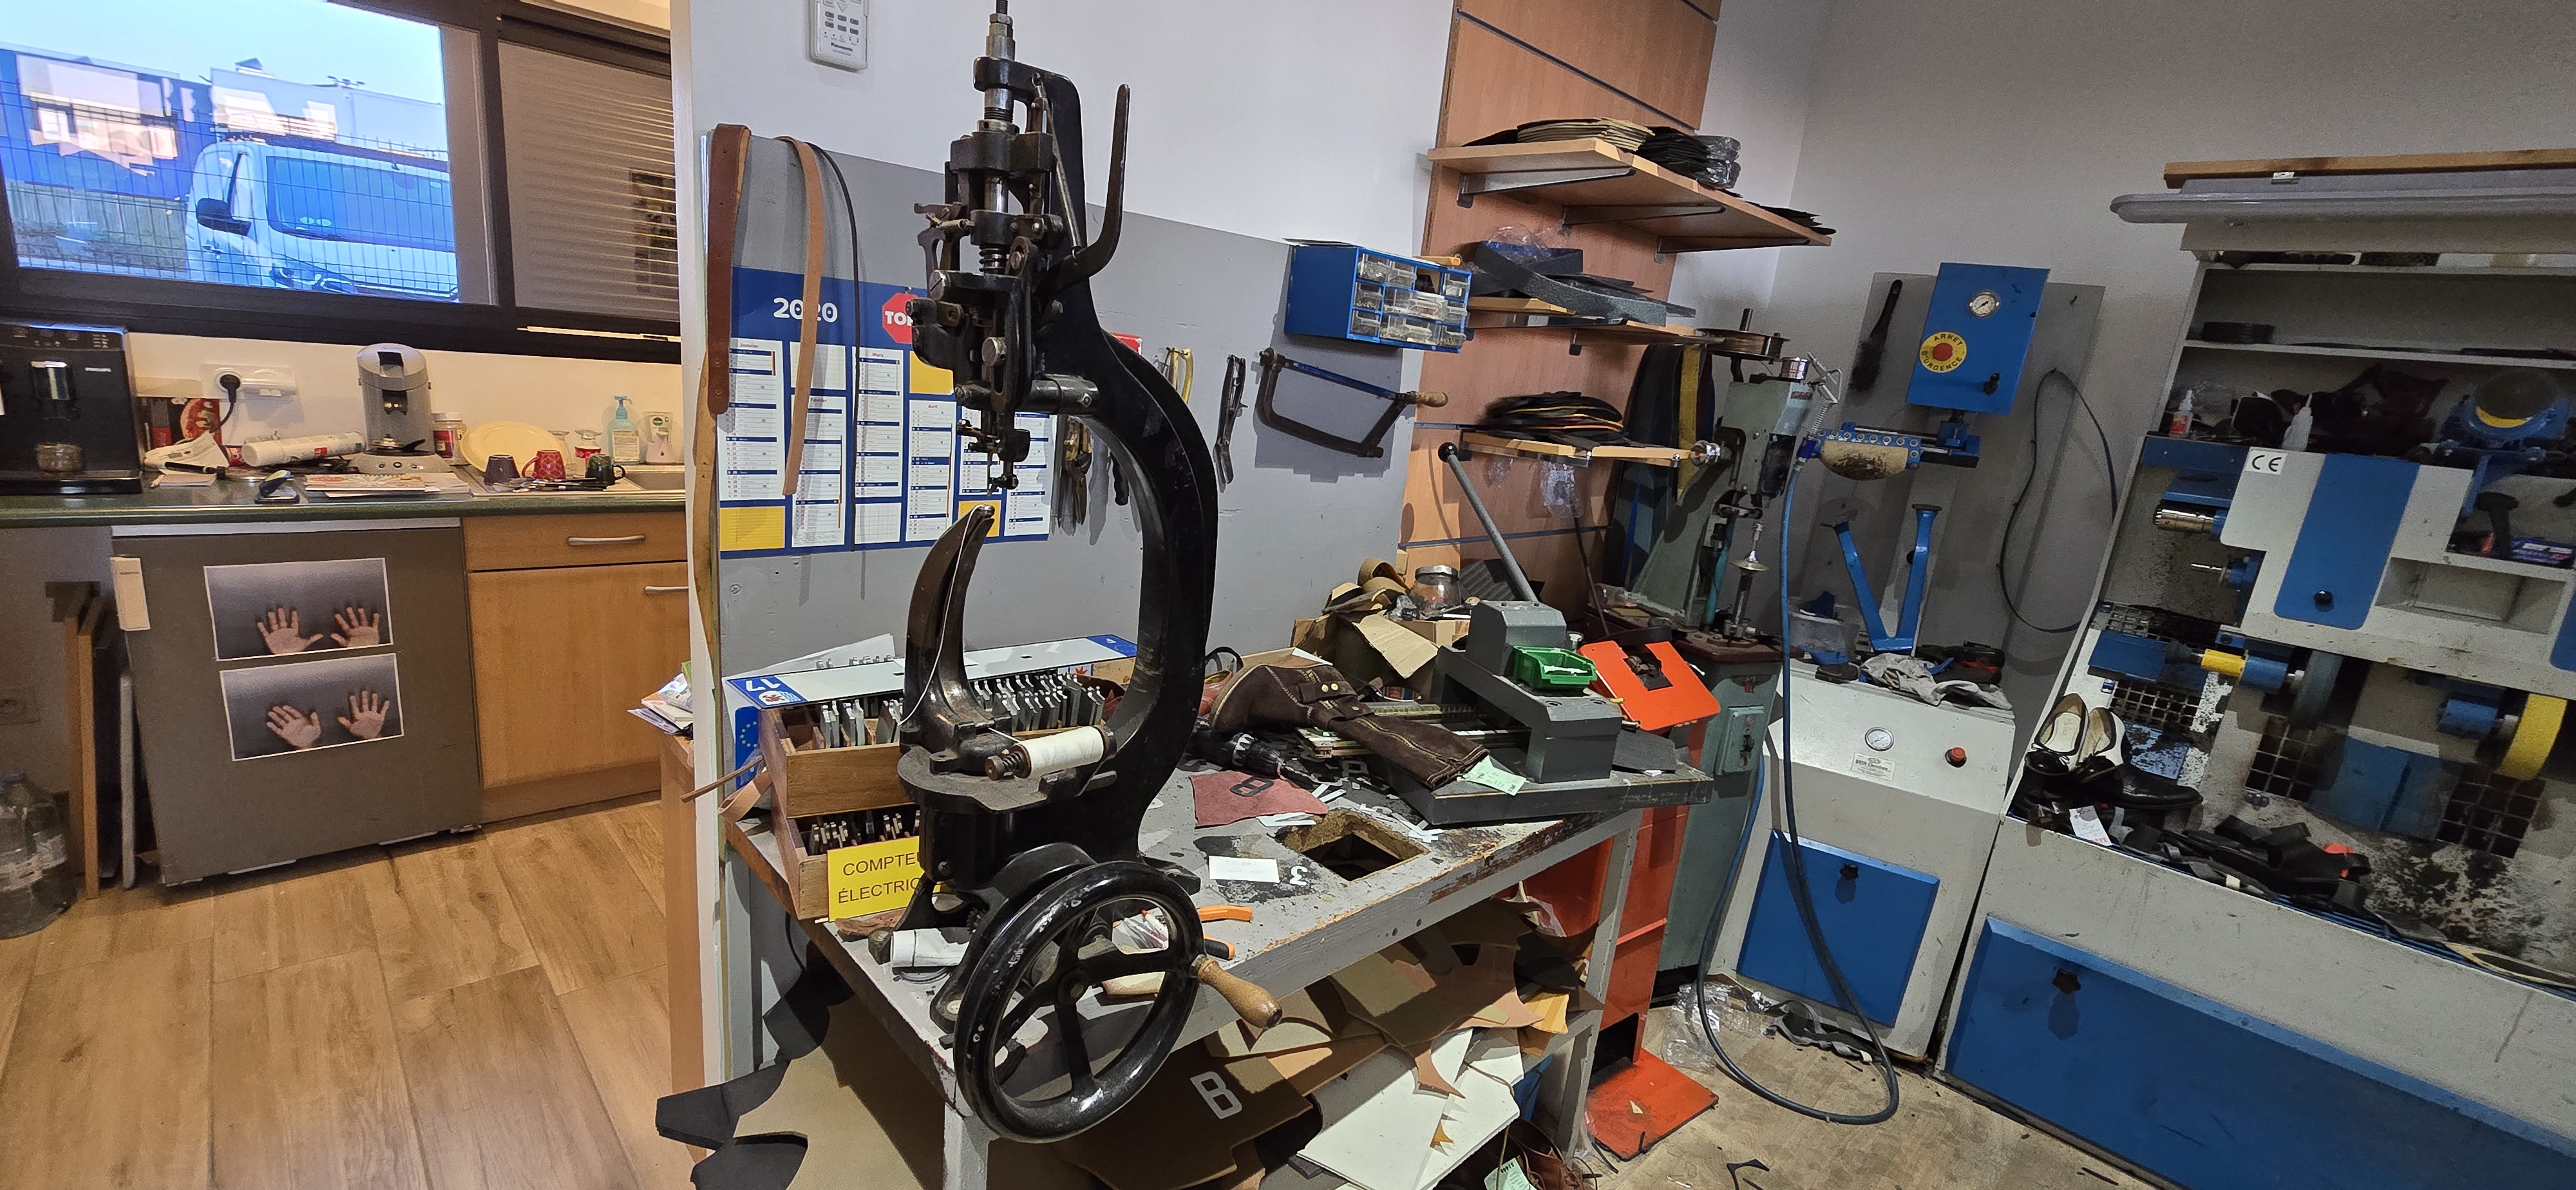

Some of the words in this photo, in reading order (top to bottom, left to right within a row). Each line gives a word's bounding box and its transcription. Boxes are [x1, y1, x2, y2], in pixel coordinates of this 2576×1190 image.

[773, 298, 837, 322] 200
[1922, 350, 1962, 372] D'URGENCE
[2252, 455, 2282, 472] CE
[746, 678, 781, 692] 17
[1189, 1071, 1243, 1119] B
